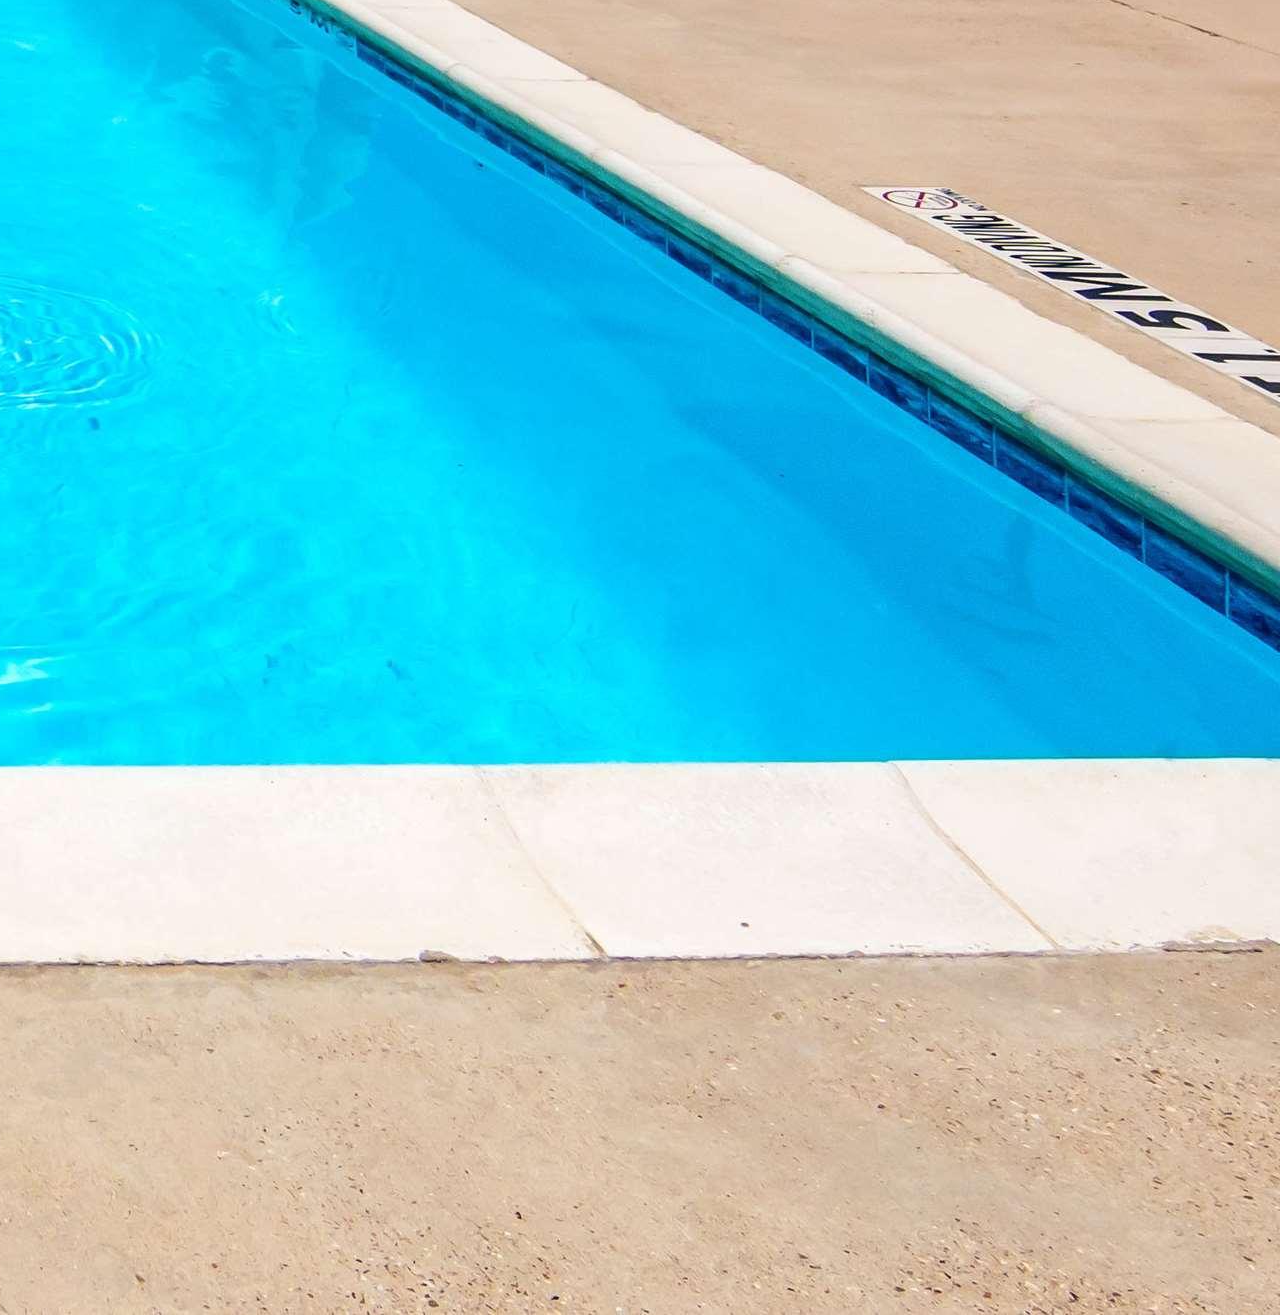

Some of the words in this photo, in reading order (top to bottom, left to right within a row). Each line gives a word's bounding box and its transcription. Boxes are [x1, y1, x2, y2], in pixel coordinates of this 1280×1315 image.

[931, 215, 1068, 252] DIVING
[1009, 254, 1103, 269] NO
[1038, 271, 1175, 302] M
